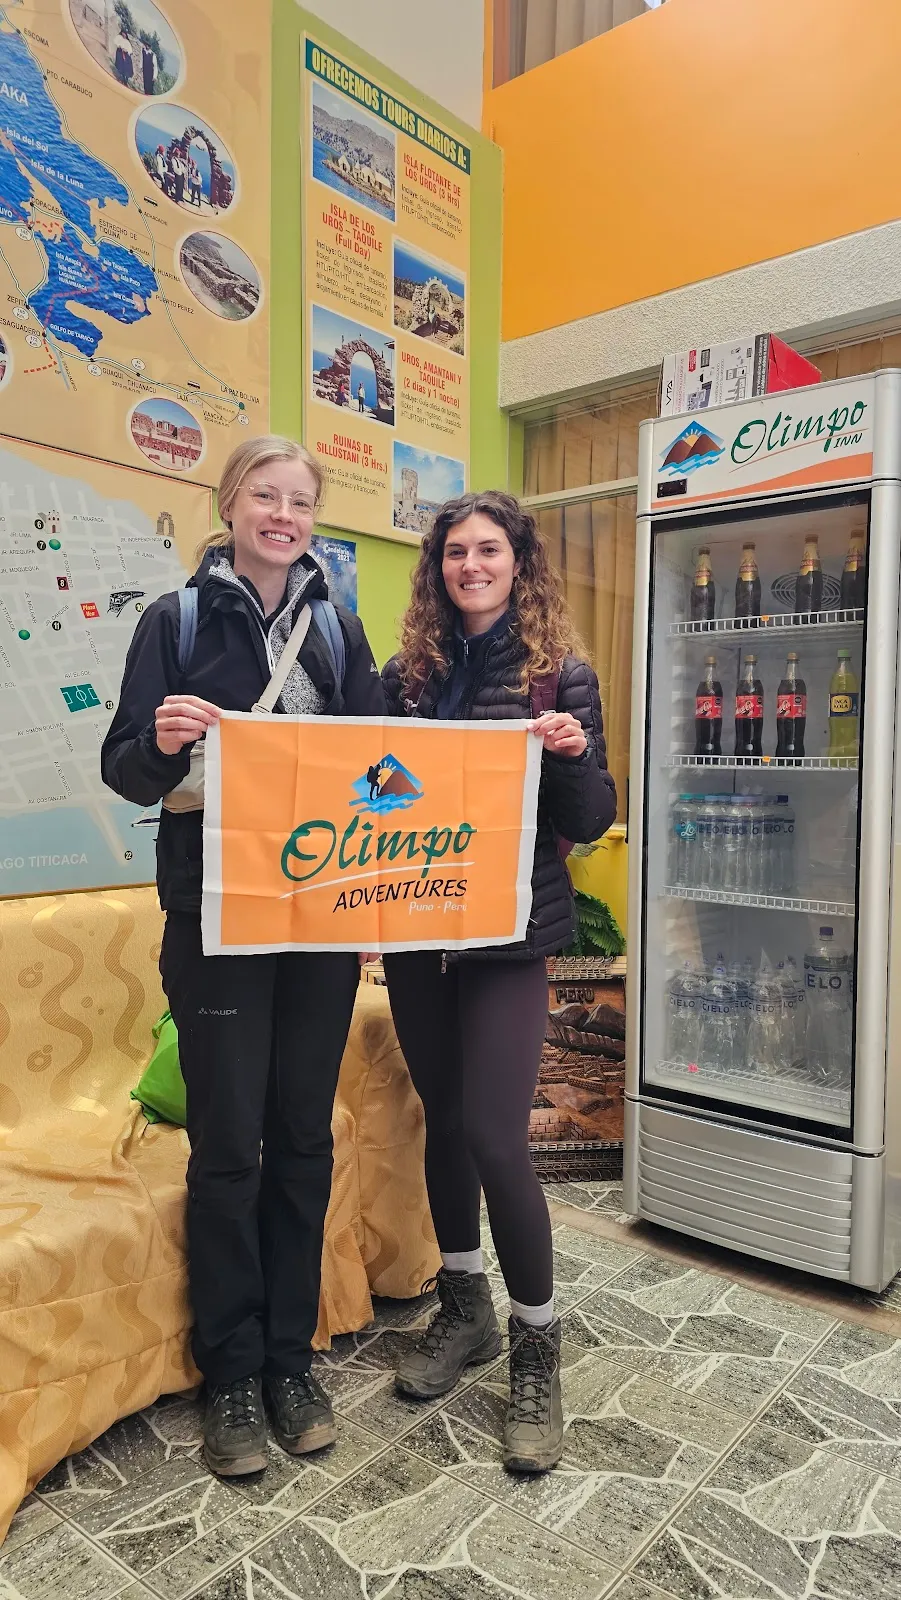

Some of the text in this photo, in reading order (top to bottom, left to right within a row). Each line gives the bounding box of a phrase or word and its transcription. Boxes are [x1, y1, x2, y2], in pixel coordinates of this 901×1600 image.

[23, 27, 50, 48] ESCOMA
[60, 76, 93, 98] CARABUCO
[312, 47, 467, 169] OFRECEMOS TOURS DIARIOS A:
[6, 127, 49, 153] Isla del Sol
[31, 158, 84, 189] Isla de la Luna
[403, 152, 461, 197] ISLA FLOTANTE DE
[405, 166, 460, 209] LOS UROS (3 Hrs)
[330, 202, 375, 236] ISLA DE LOS
[322, 211, 383, 253] UROS TAQUILE
[335, 232, 371, 261] (Full Day)
[49, 323, 67, 334] GOLFO
[401, 351, 462, 385] UROS, AMANTANI Y
[403, 376, 411, 389] (2
[418, 370, 446, 390] TAQUILE
[220, 385, 260, 404] LA PAZ BOLIVIA
[731, 401, 868, 464] Olimpo
[833, 432, 863, 449] INN
[333, 433, 373, 456] RUINAS DE
[316, 441, 388, 475] SILLUSTANI (3 Hrs.)
[136, 604, 143, 612] 10
[53, 621, 60, 630] 11
[106, 701, 113, 709] 13
[281, 815, 478, 882] Olimpo
[28, 852, 88, 868] TITICACA
[332, 879, 468, 913] ADVENTURES
[408, 900, 434, 915] Puno
[556, 987, 595, 1004] PERU
[209, 1008, 238, 1016] VAUDE
[702, 1001, 730, 1014] CIELO
